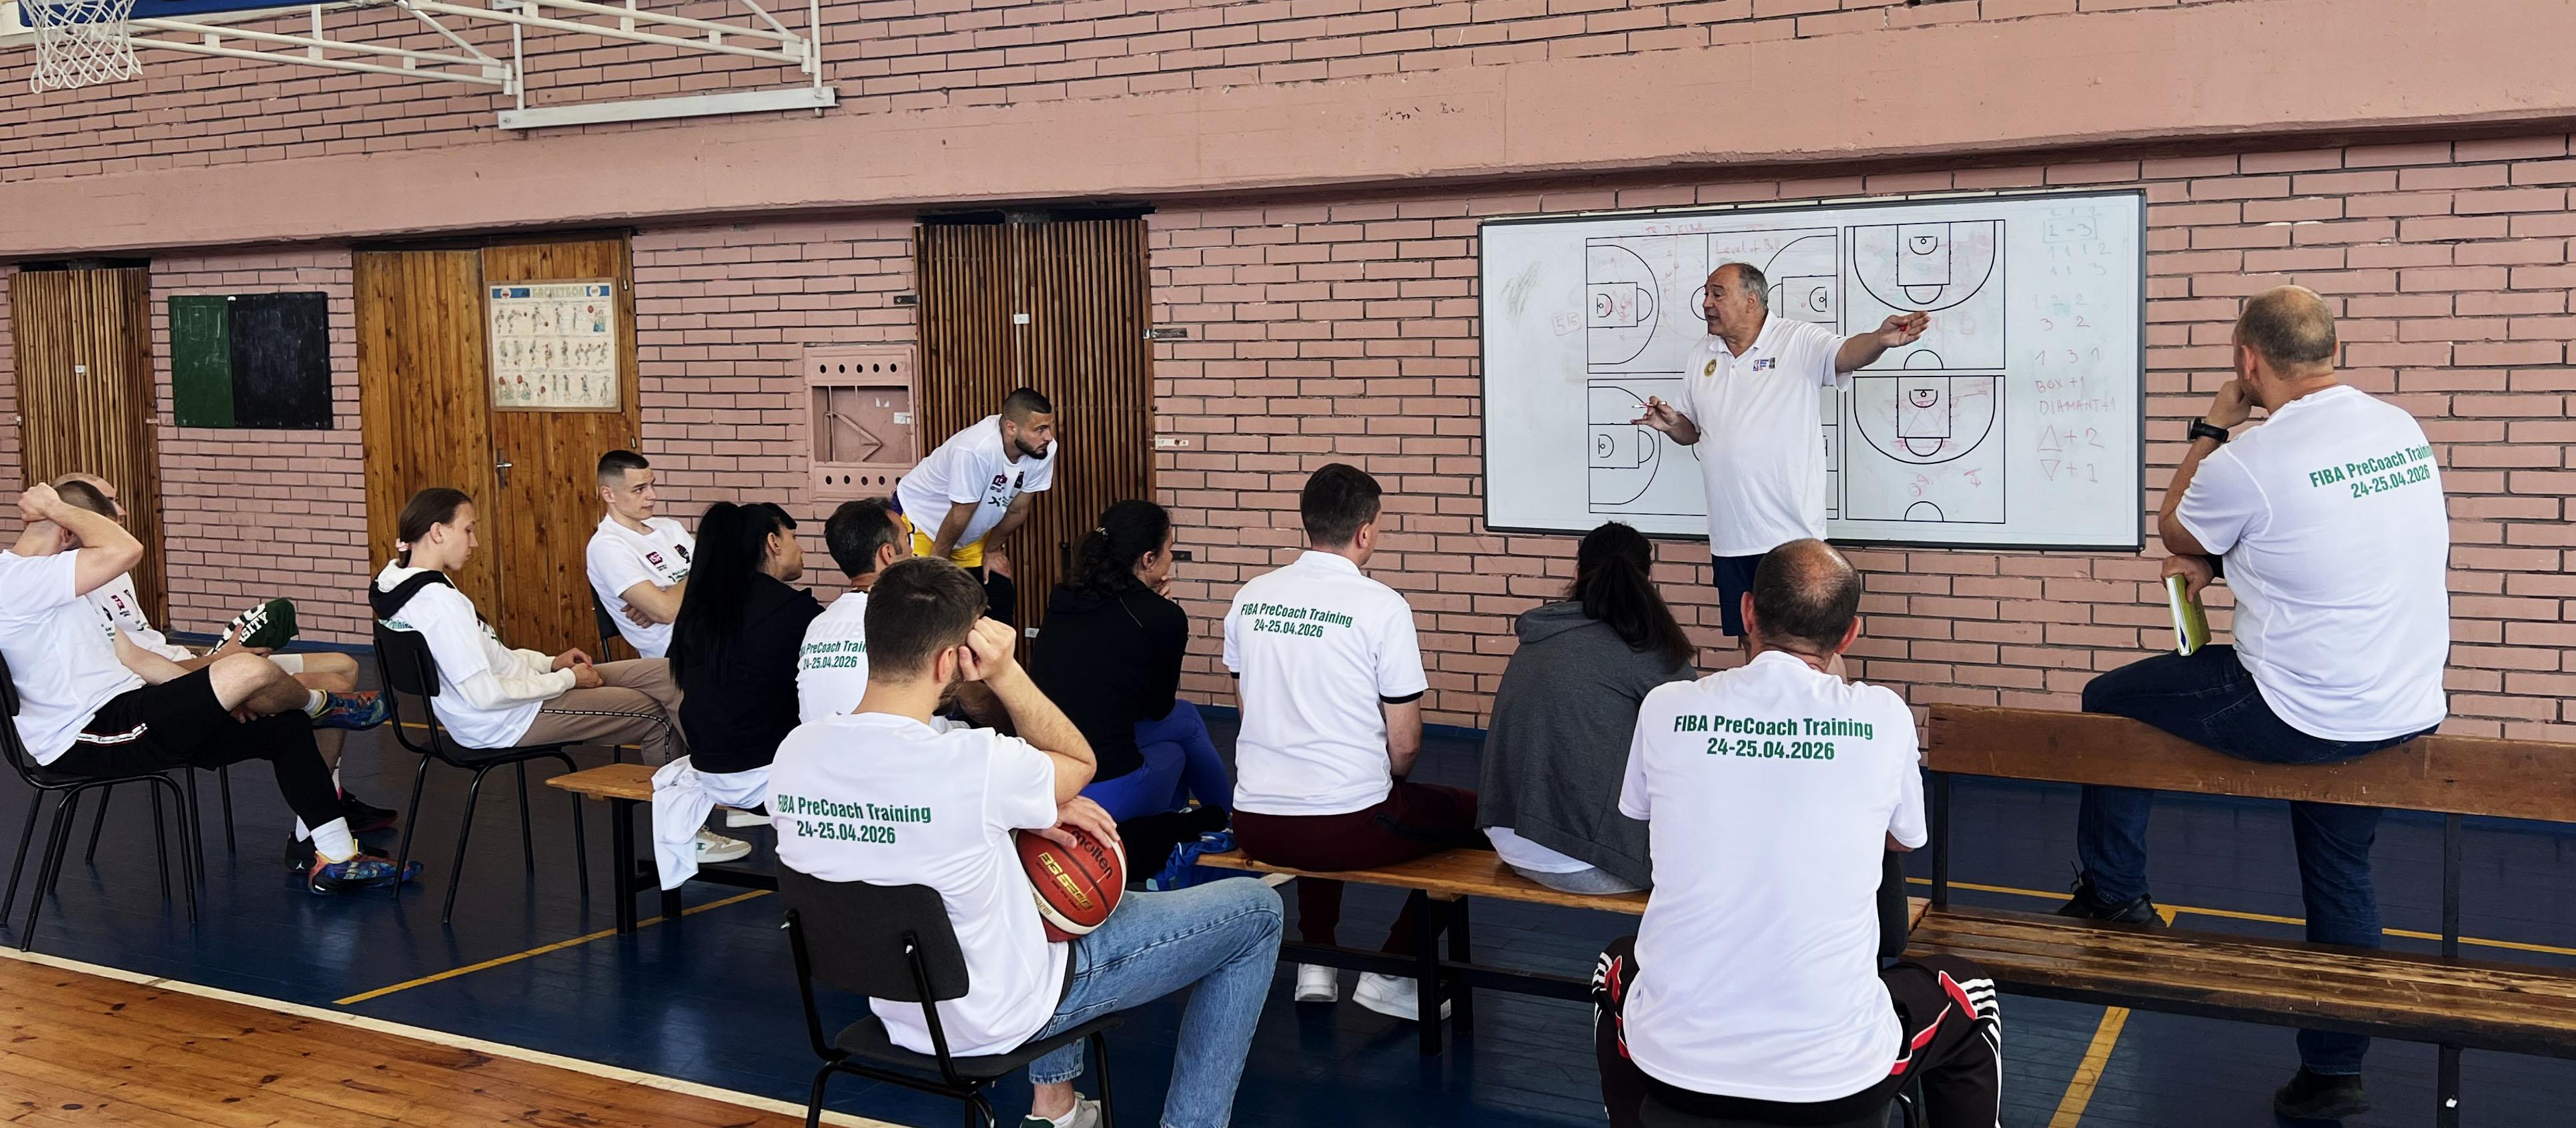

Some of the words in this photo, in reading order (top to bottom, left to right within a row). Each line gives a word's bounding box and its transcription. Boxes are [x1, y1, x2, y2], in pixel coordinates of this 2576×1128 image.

[2076, 315, 2092, 328] 2
[2309, 467, 2346, 487] FIBA
[2346, 451, 2407, 478] PreCoach
[2350, 465, 2431, 499] 24-25.04.2026
[1241, 603, 1258, 615] FIBA
[1259, 603, 1307, 619] PreCoach
[1309, 609, 1353, 627] Training
[1254, 618, 1324, 638] 24-25.04.2026
[806, 641, 841, 654] PreCoach
[1674, 715, 1708, 732] FIBA
[1713, 715, 1798, 736] PreCoach
[1803, 718, 1873, 740] Training
[1707, 738, 1835, 760] 24-25.04.2026
[798, 797, 864, 819] PreCoach
[866, 803, 931, 824] Training
[797, 820, 896, 844] 24-25.04.2026
